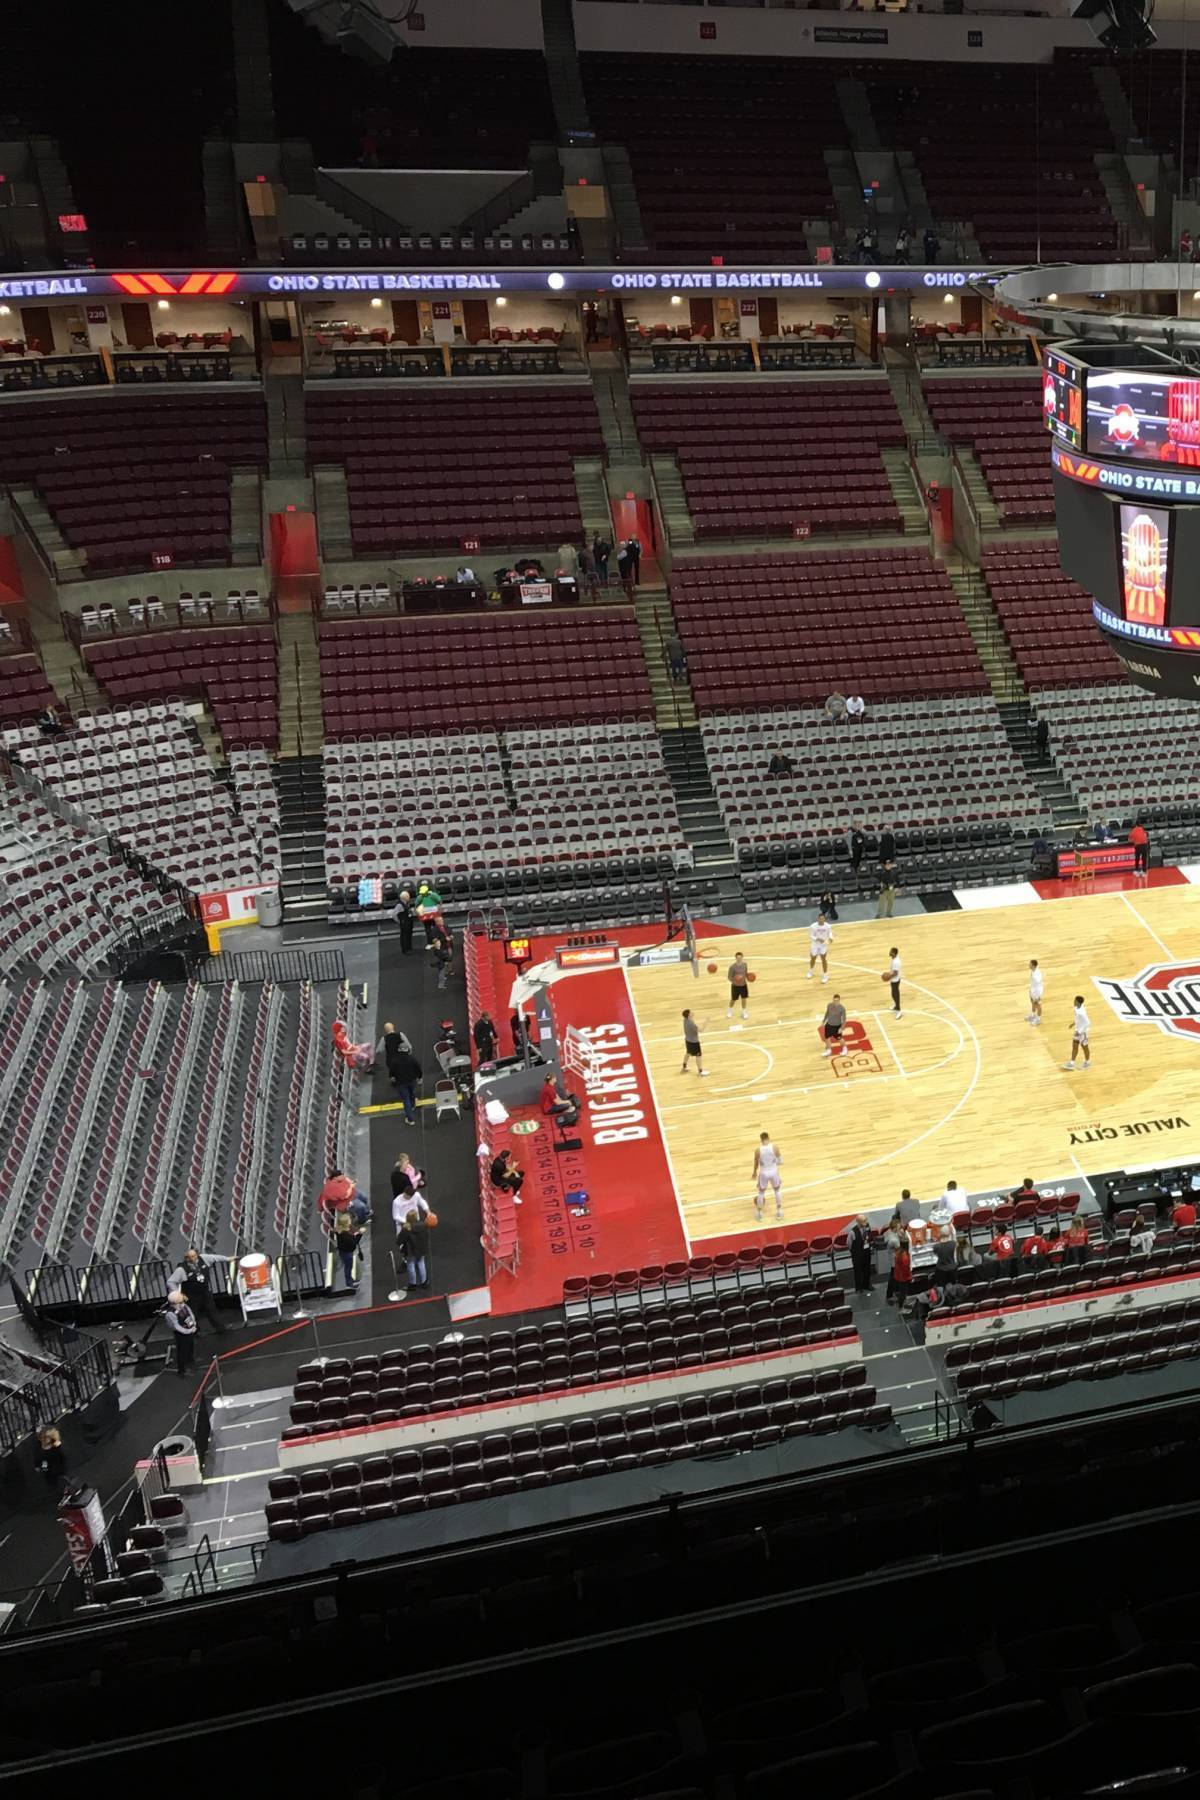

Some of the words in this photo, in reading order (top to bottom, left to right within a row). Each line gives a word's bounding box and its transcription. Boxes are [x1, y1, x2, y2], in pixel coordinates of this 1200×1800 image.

[268, 275, 317, 291] OHIO
[322, 274, 381, 290] STATE
[382, 273, 501, 290] BASKETBALL
[611, 273, 657, 288] OHIO
[660, 273, 712, 288] STATE
[715, 272, 823, 288] BASKETBALL
[923, 273, 965, 287] OHIO
[434, 306, 449, 315] 221
[1099, 470, 1133, 488] OHIO
[1135, 477, 1182, 494] STATE
[795, 527, 809, 536] 122
[463, 541, 478, 550] 121
[155, 555, 171, 565] 118
[1102, 611, 1172, 643] BASKETBALL
[577, 1023, 649, 1145] BUCKEYES
[1119, 1116, 1191, 1137] VALUE
[1069, 1126, 1119, 1146] CITY
[540, 1171, 555, 1182] 15
[542, 1186, 557, 1196] 16
[544, 1199, 560, 1208] 17
[547, 1213, 562, 1224] 18
[549, 1227, 565, 1238] 19
[576, 1223, 592, 1232] 9
[579, 1236, 596, 1248] 10
[551, 1241, 568, 1255] 20
[1030, 1244, 1038, 1255] 4
